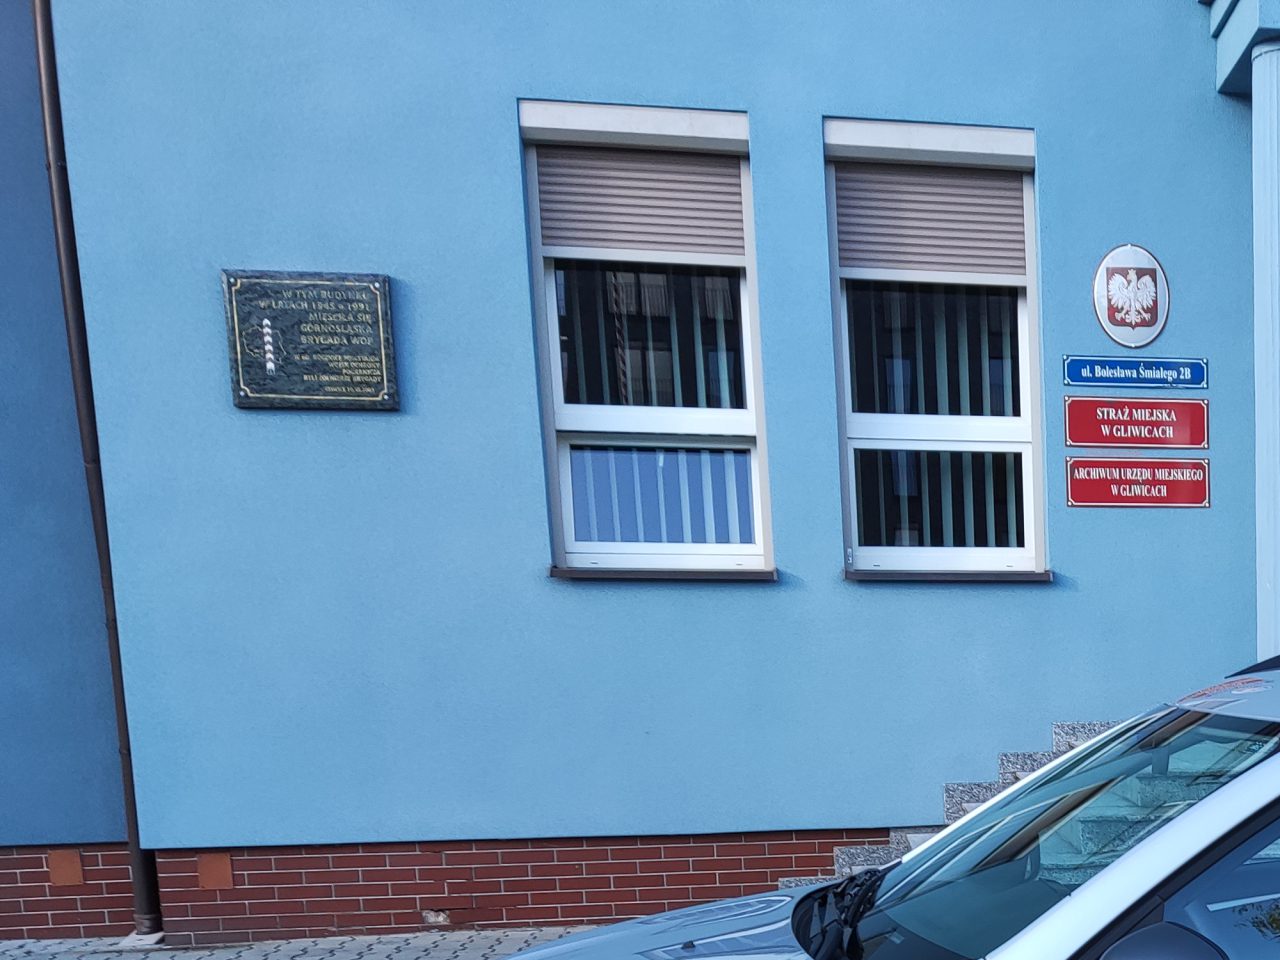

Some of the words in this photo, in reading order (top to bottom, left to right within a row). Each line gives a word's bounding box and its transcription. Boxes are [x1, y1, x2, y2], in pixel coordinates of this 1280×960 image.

[300, 335, 349, 345] BRYGADA
[1081, 365, 1092, 377] ul.
[1095, 365, 1137, 378] Bolesława
[1139, 362, 1177, 382] Śmiałego
[1179, 367, 1191, 380] 2B
[1096, 405, 1130, 421] STRAŻ
[1132, 408, 1177, 422] MIEJSKA
[1101, 424, 1112, 437] W
[1113, 425, 1174, 438] GLIWICACH
[1073, 467, 1119, 480] ARCHIWUM
[1120, 468, 1153, 483] URZĘDU
[1154, 468, 1204, 481] MIEJSKIEGO
[1110, 484, 1119, 496] W
[1120, 484, 1167, 497] GLIWICACH
